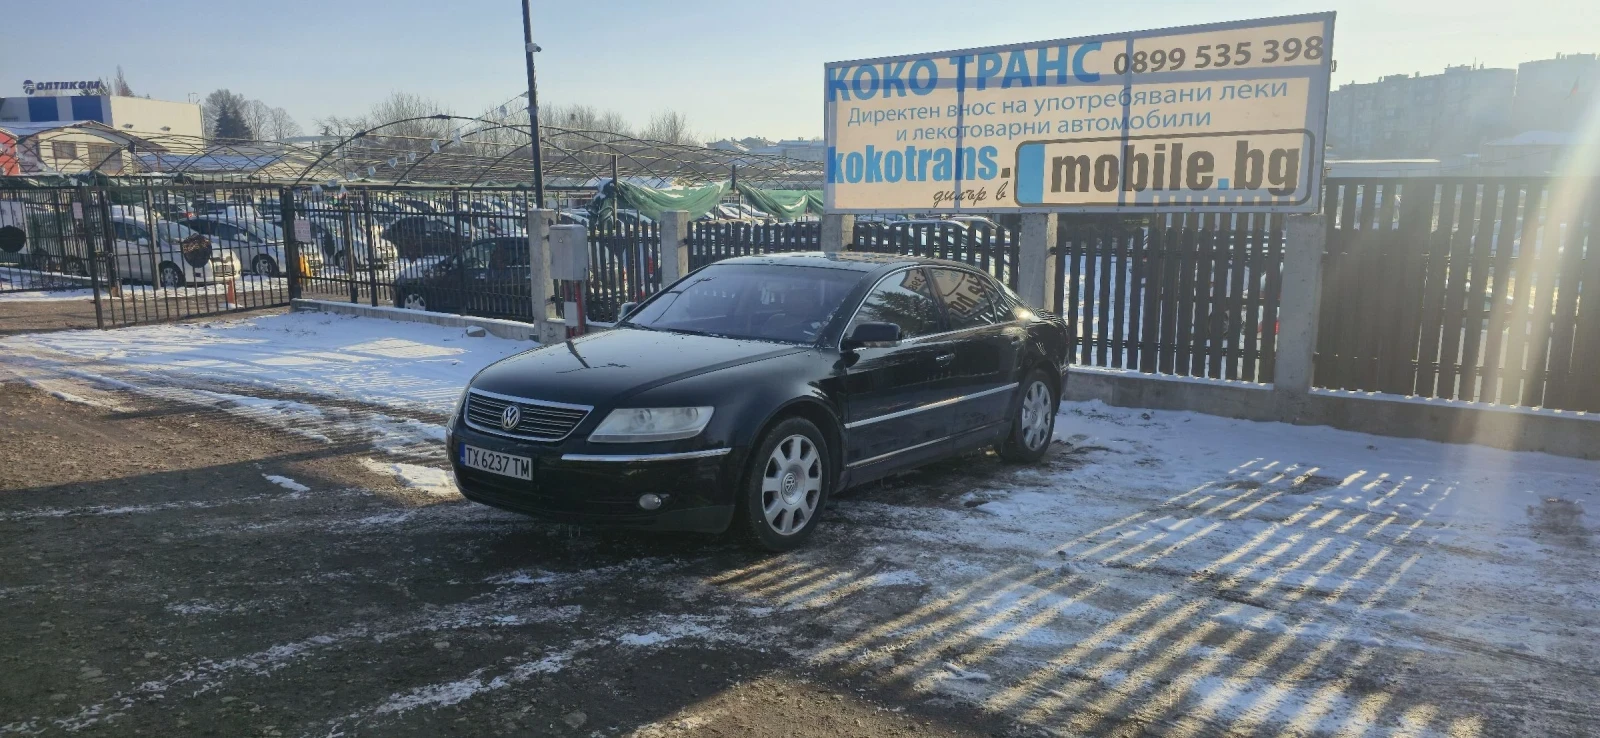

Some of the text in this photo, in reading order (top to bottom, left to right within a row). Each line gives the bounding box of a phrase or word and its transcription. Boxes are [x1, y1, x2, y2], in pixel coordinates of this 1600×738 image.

[828, 42, 1103, 103] КОКО ТРАНС
[1113, 35, 1324, 76] 0899 535 398
[848, 81, 1288, 126] Директен внос на употребявани леки
[896, 109, 1211, 142] и лекотоварни автомобили
[466, 447, 530, 478] TX 6237 TM
